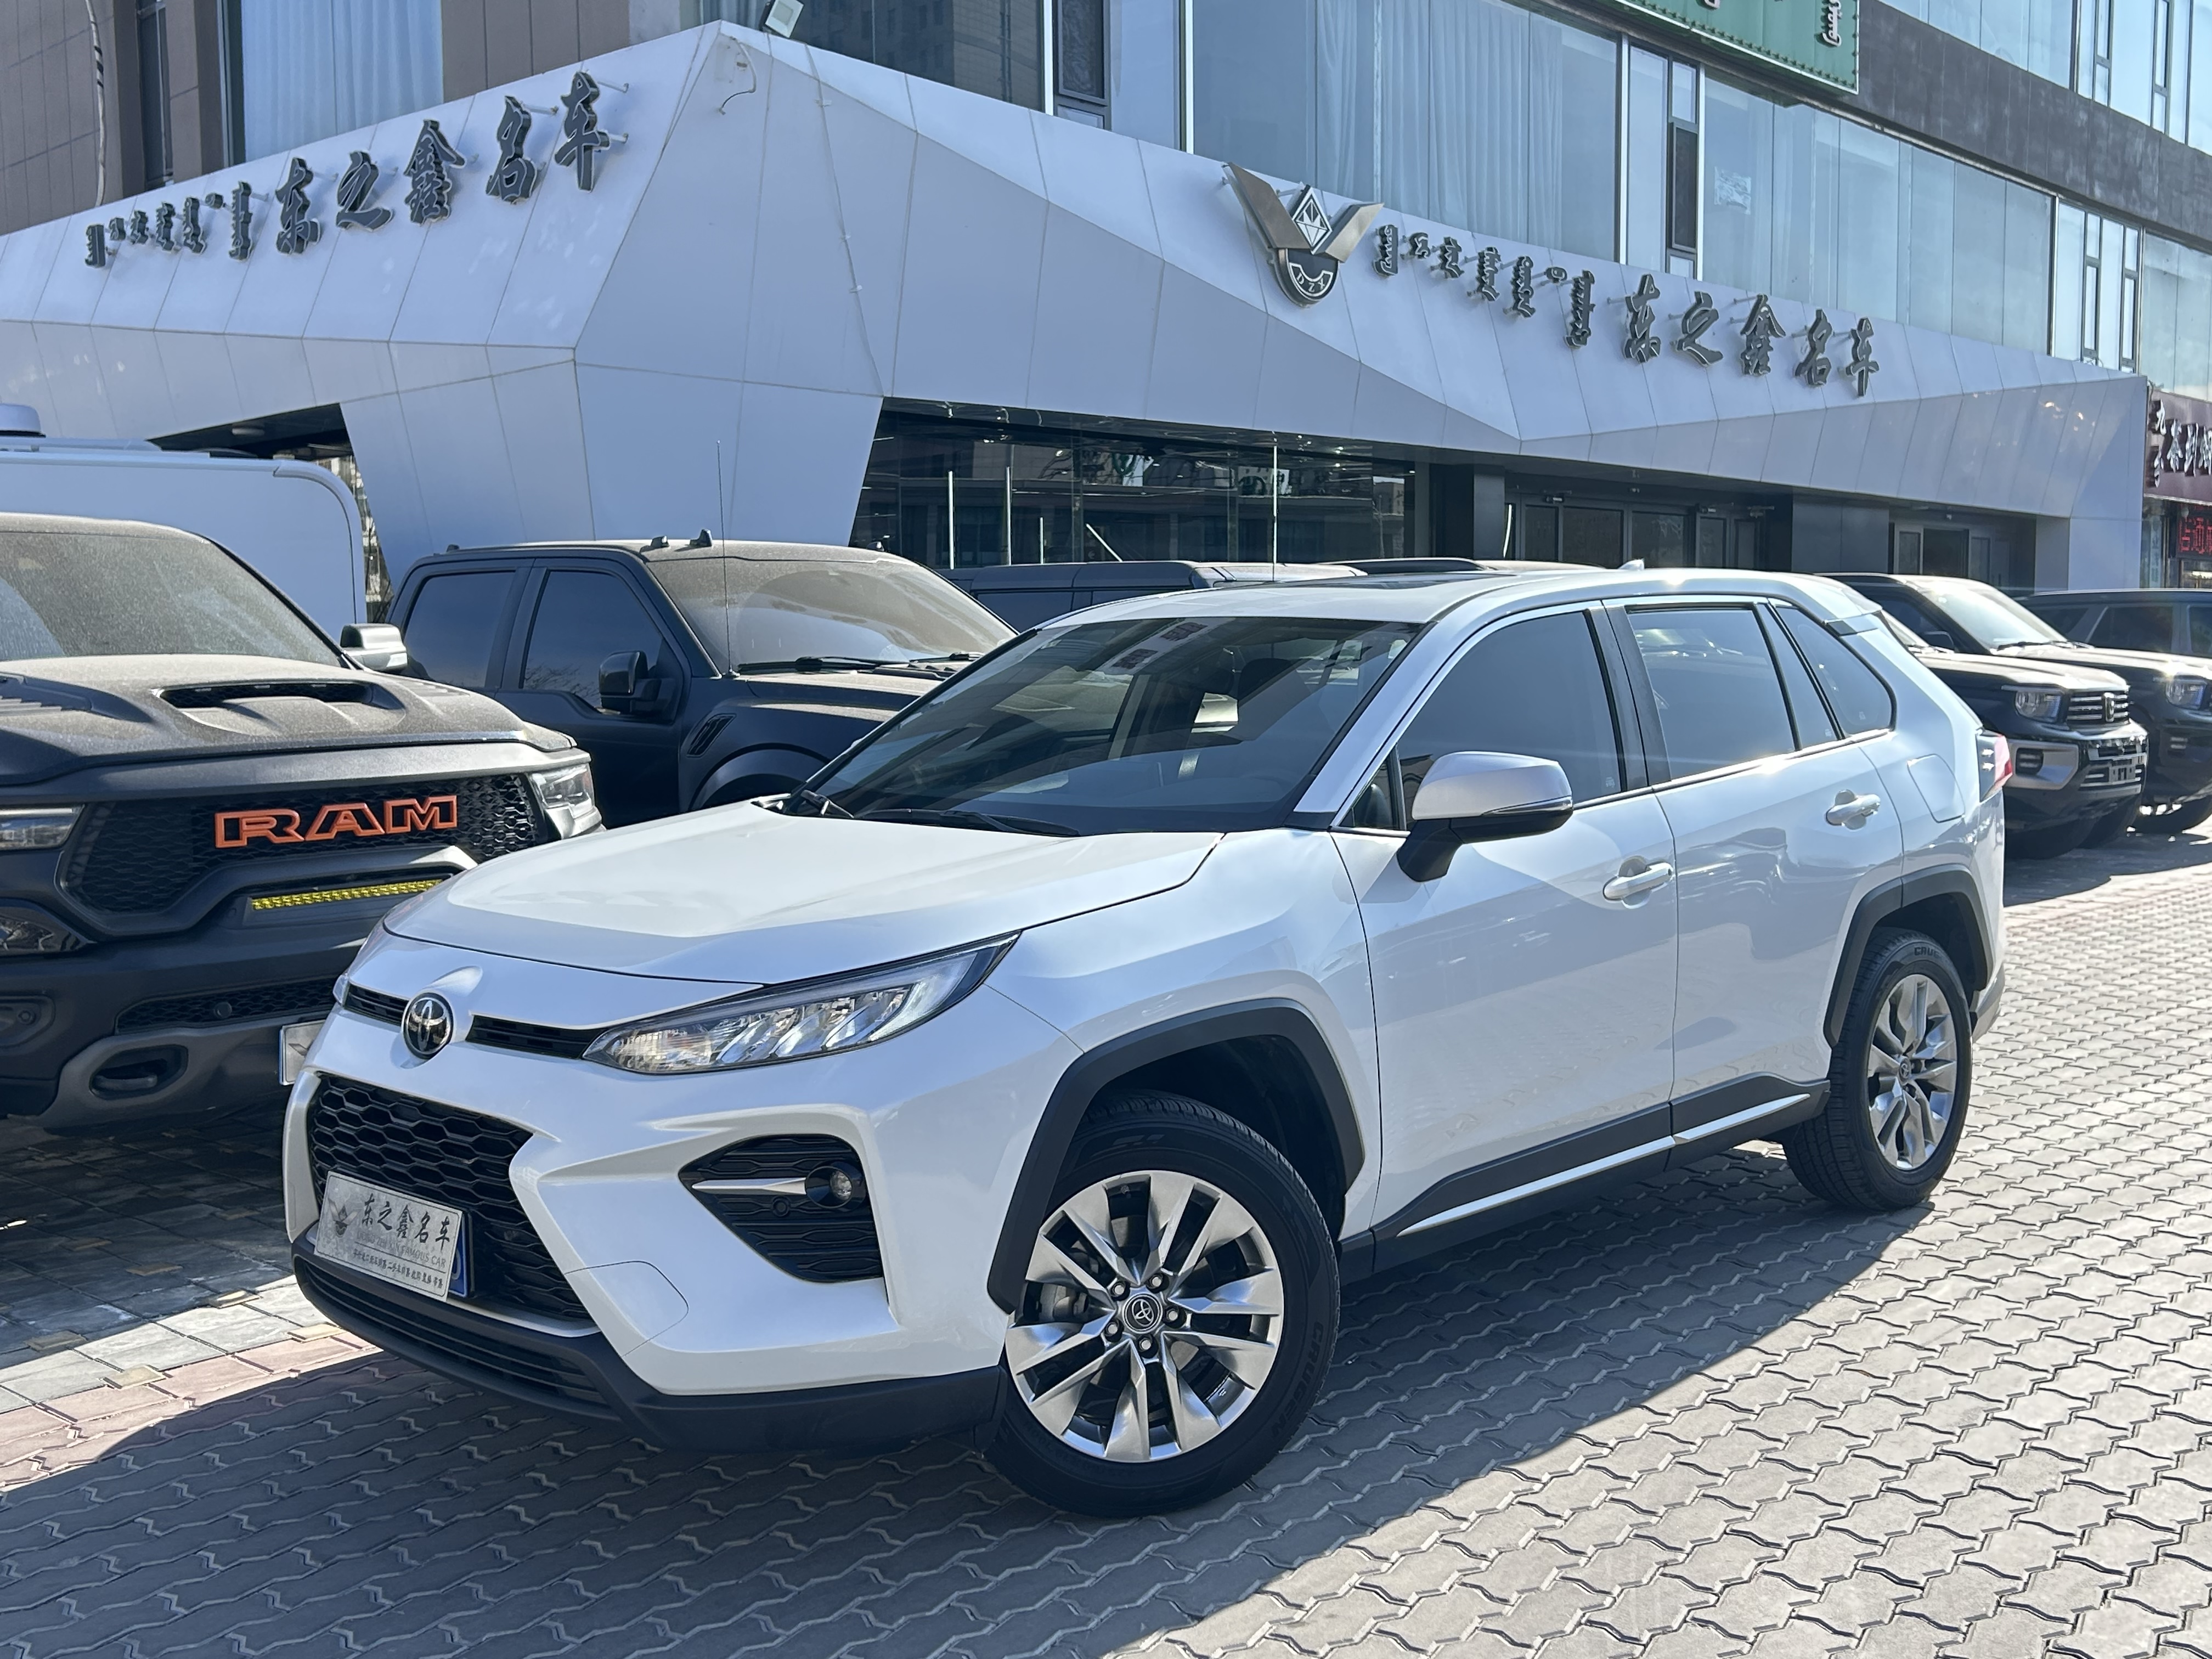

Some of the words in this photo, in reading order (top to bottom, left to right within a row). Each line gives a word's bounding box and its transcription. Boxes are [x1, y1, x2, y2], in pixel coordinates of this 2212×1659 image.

[1296, 272, 1325, 292] DZX
[215, 795, 458, 848] RAM
[431, 1255, 446, 1268] CAR
